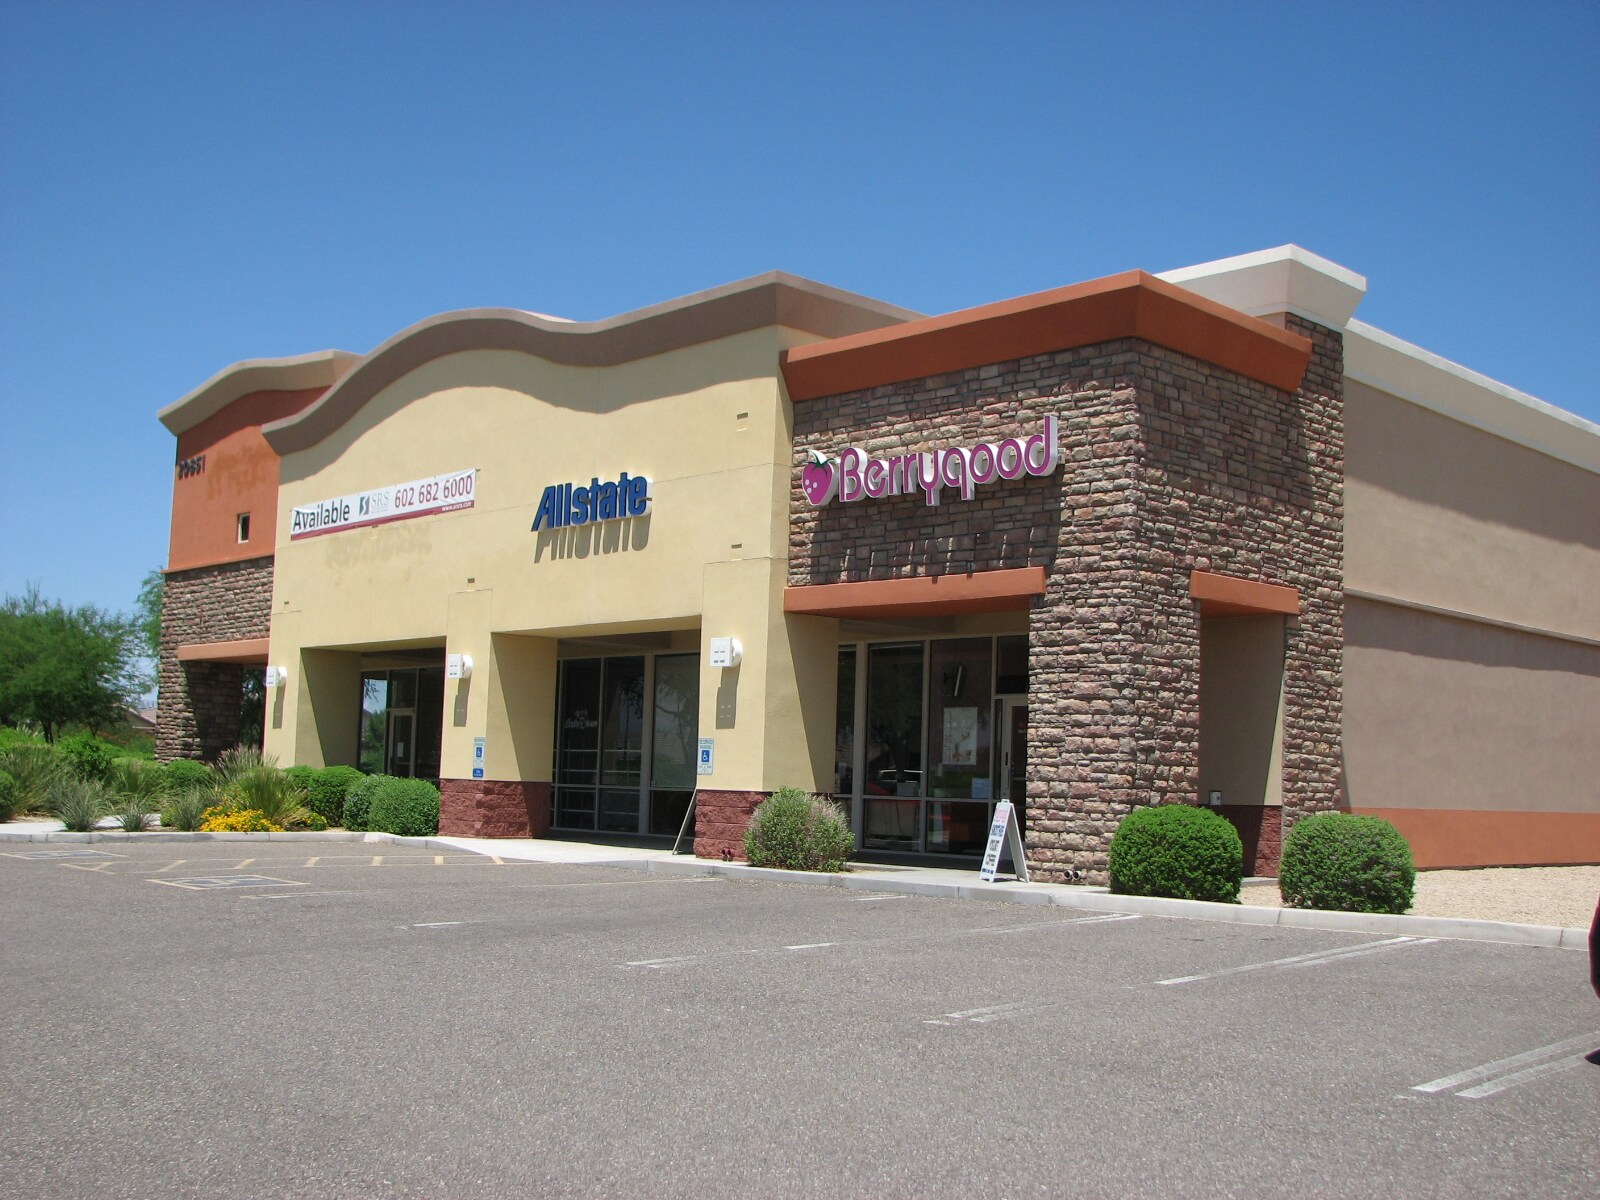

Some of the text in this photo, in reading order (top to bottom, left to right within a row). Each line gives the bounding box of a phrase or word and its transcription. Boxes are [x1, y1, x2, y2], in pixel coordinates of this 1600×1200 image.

[292, 499, 351, 532] Available
[395, 487, 415, 508] 602
[418, 482, 439, 504] 682
[443, 474, 473, 500] 6000
[530, 472, 650, 532] Allstate
